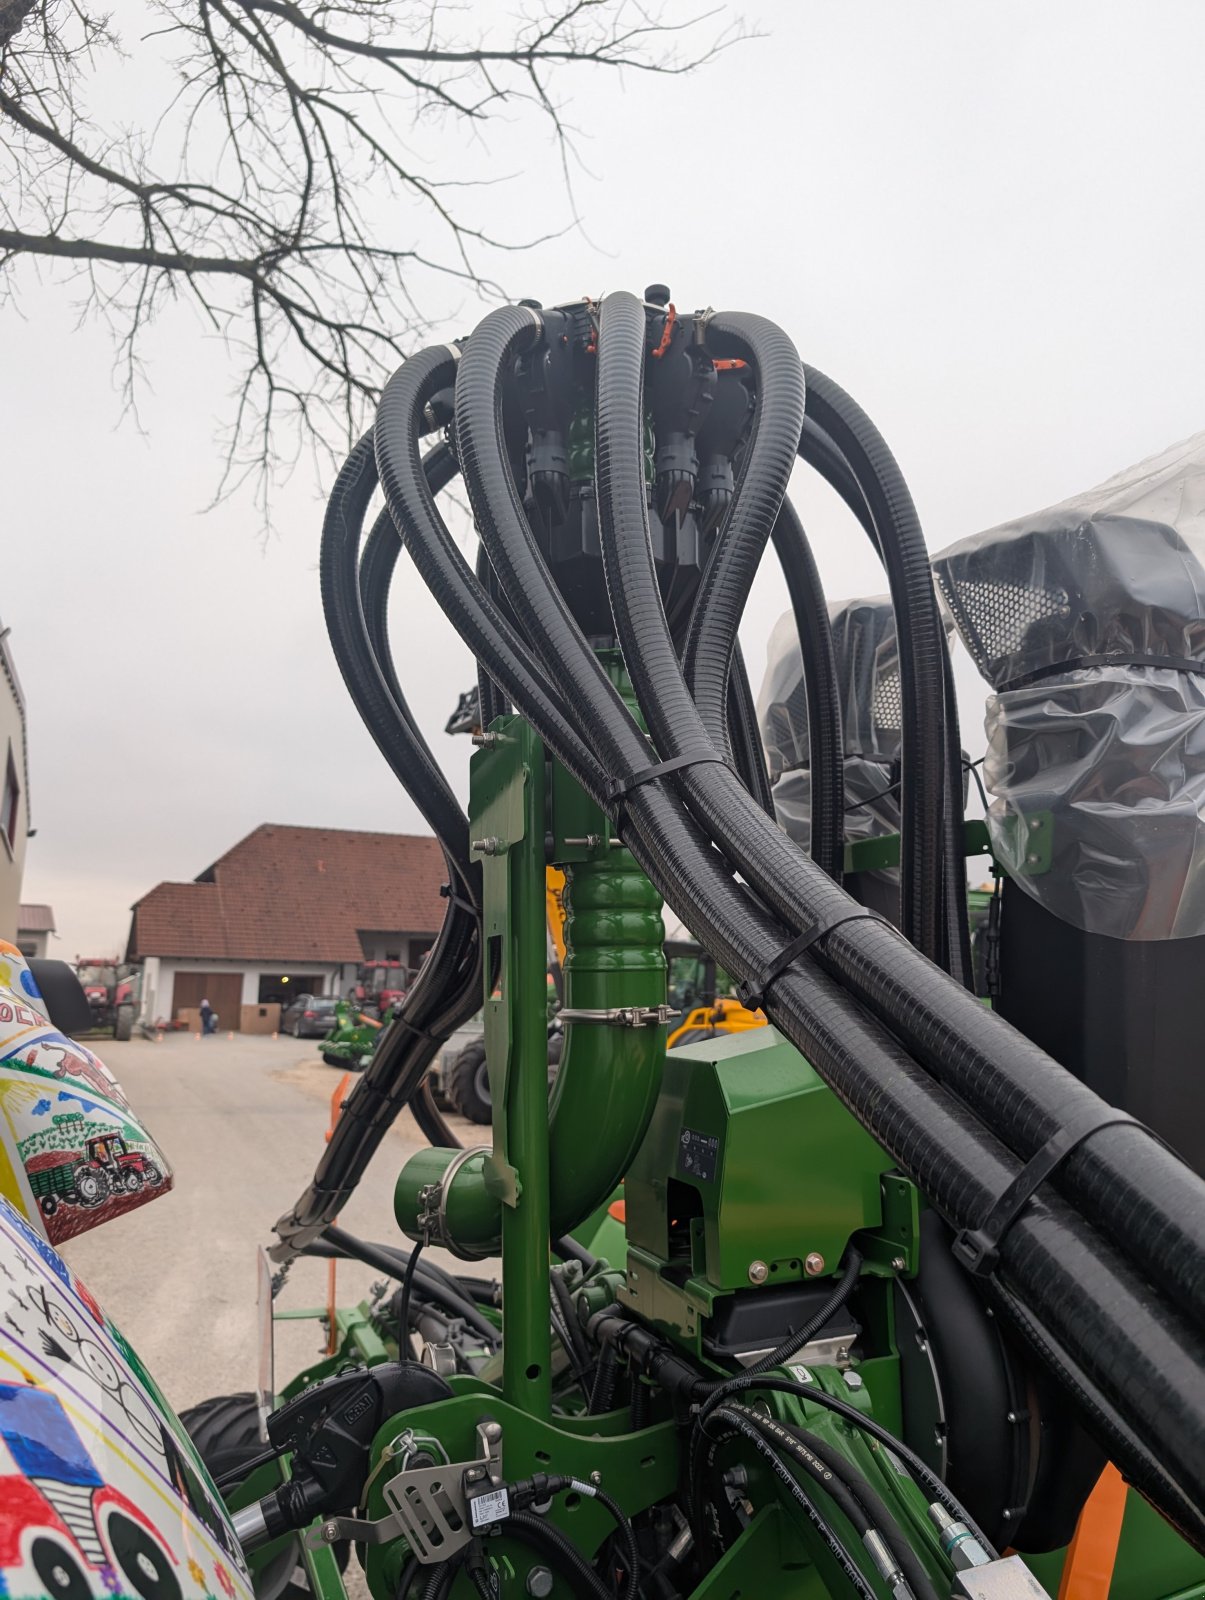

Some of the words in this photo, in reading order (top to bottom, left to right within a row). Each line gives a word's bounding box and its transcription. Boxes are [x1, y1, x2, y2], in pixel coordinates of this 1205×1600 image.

[772, 1460, 791, 1484] 1200
[792, 1486, 809, 1508] BAR
[826, 1535, 843, 1559] 300
[844, 1562, 863, 1589] BAR
